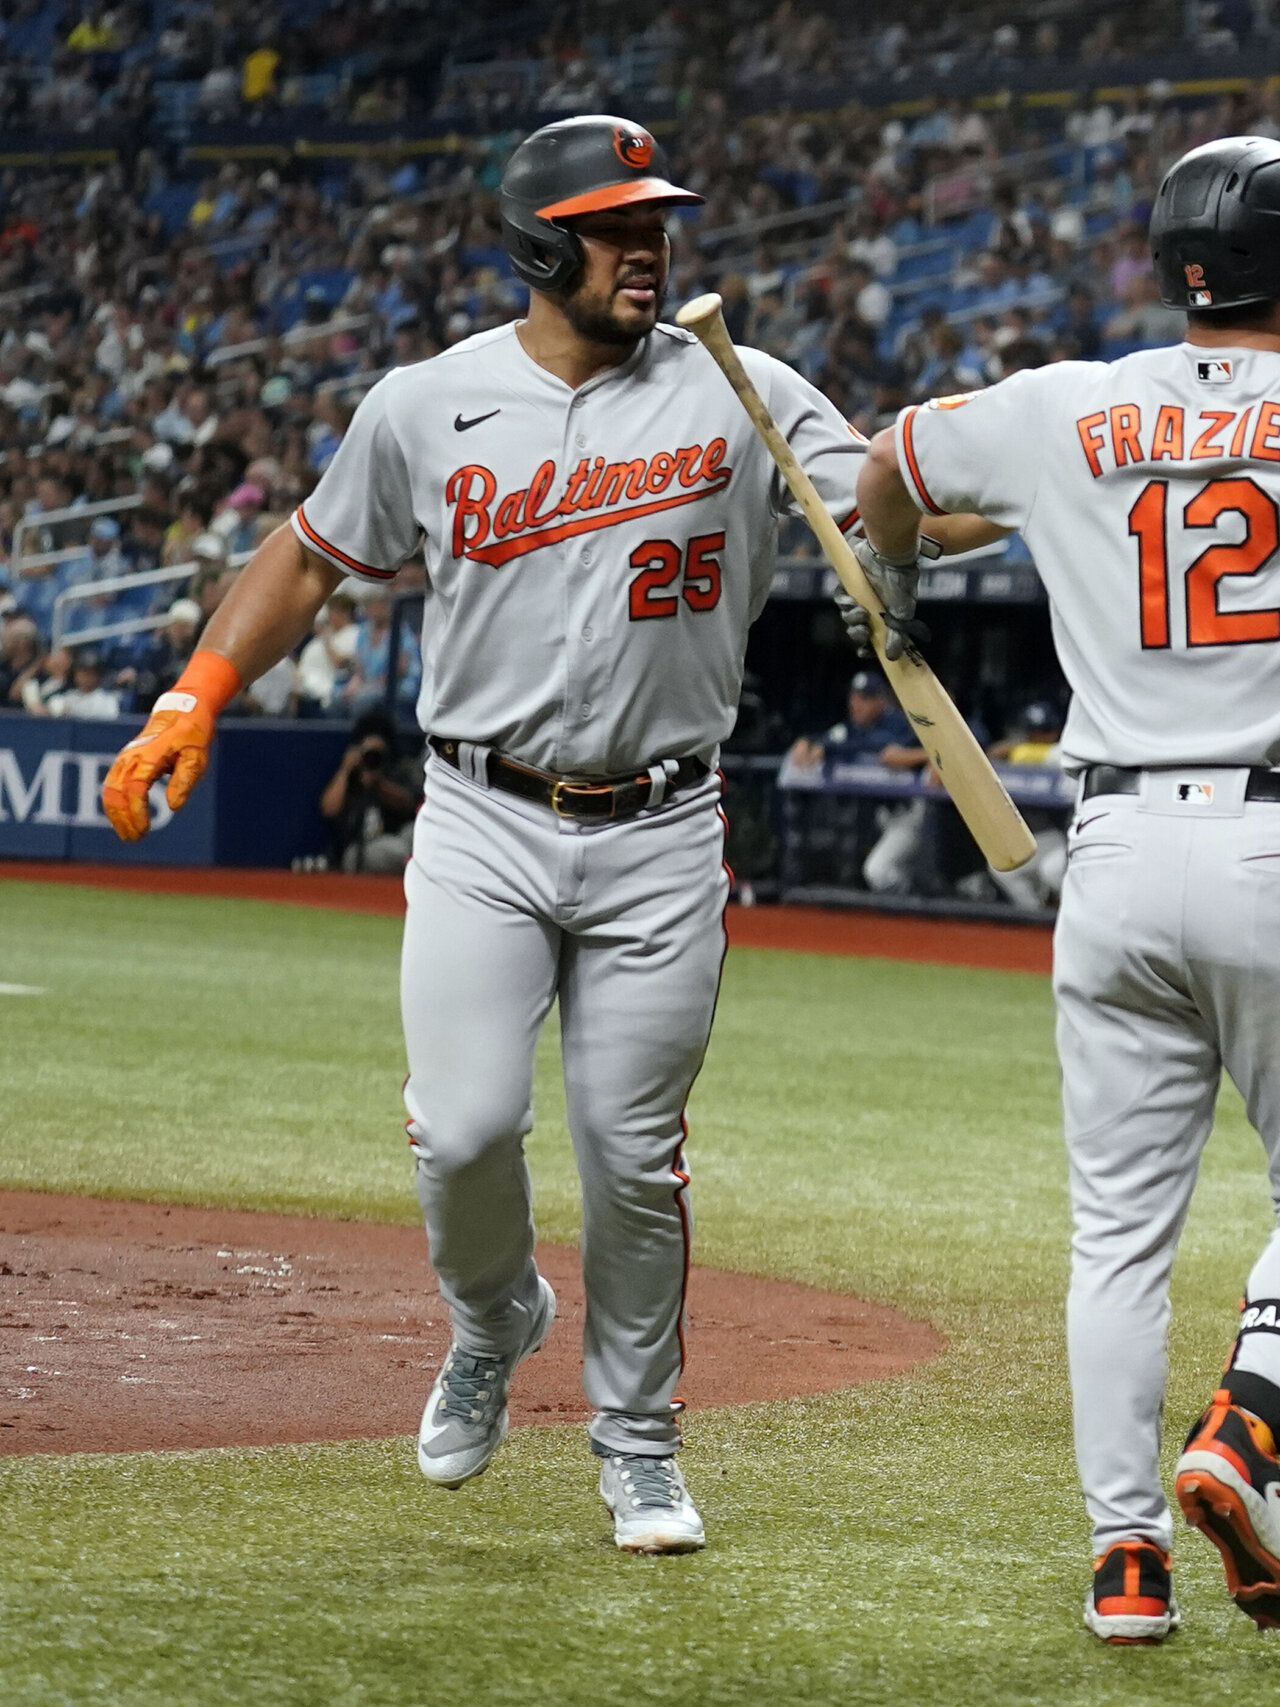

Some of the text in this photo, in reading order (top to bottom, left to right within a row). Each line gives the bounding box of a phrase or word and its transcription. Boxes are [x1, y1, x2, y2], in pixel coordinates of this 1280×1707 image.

[1184, 263, 1207, 288] 12
[445, 437, 732, 561] Baltimore
[629, 530, 726, 622] 25
